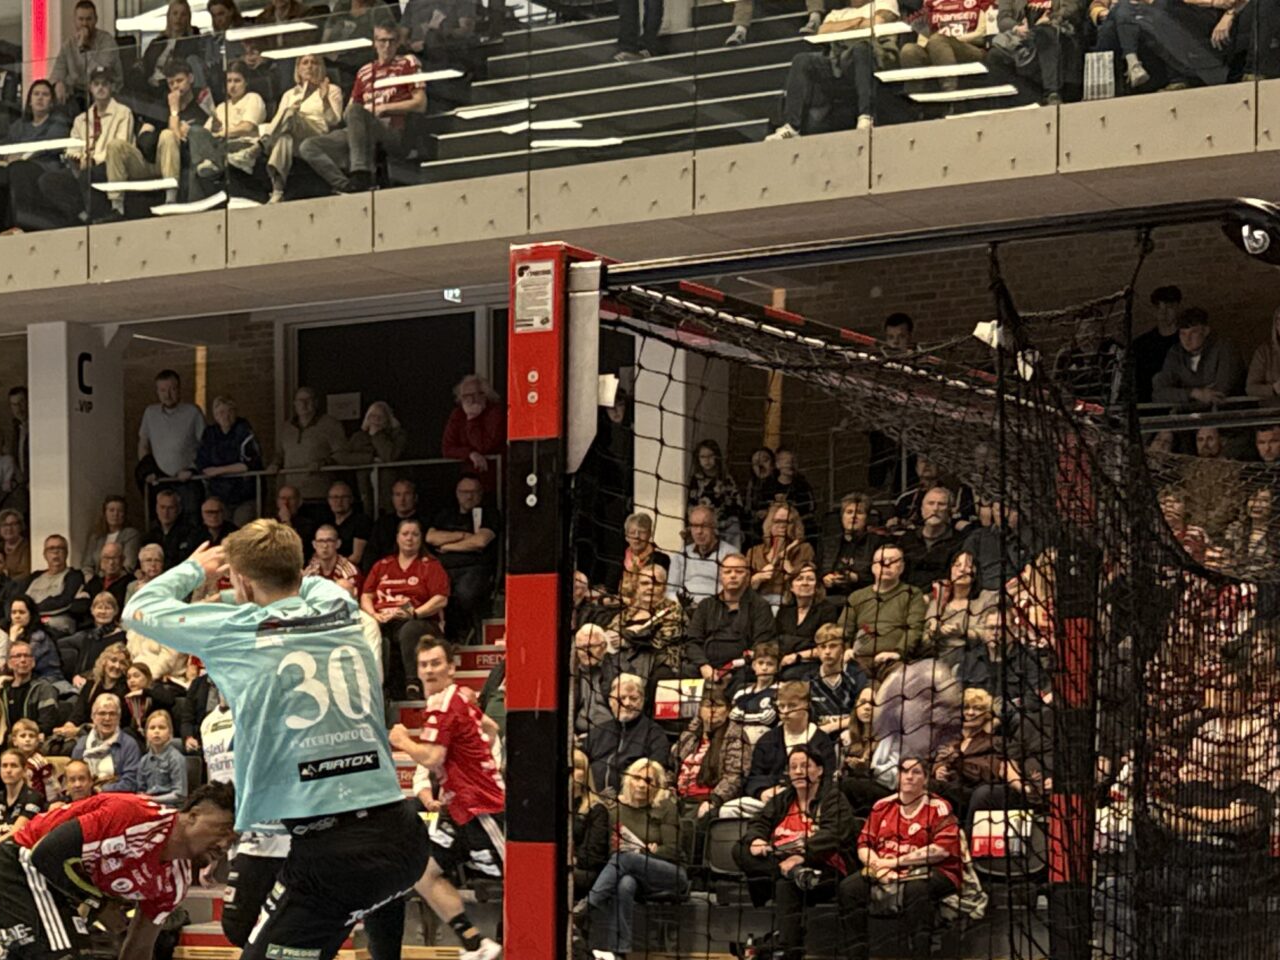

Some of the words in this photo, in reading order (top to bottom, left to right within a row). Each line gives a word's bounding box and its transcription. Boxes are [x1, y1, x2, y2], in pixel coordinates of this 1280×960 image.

[77, 352, 93, 395] C
[277, 645, 372, 729] 30
[319, 754, 374, 772] AIRTOX
